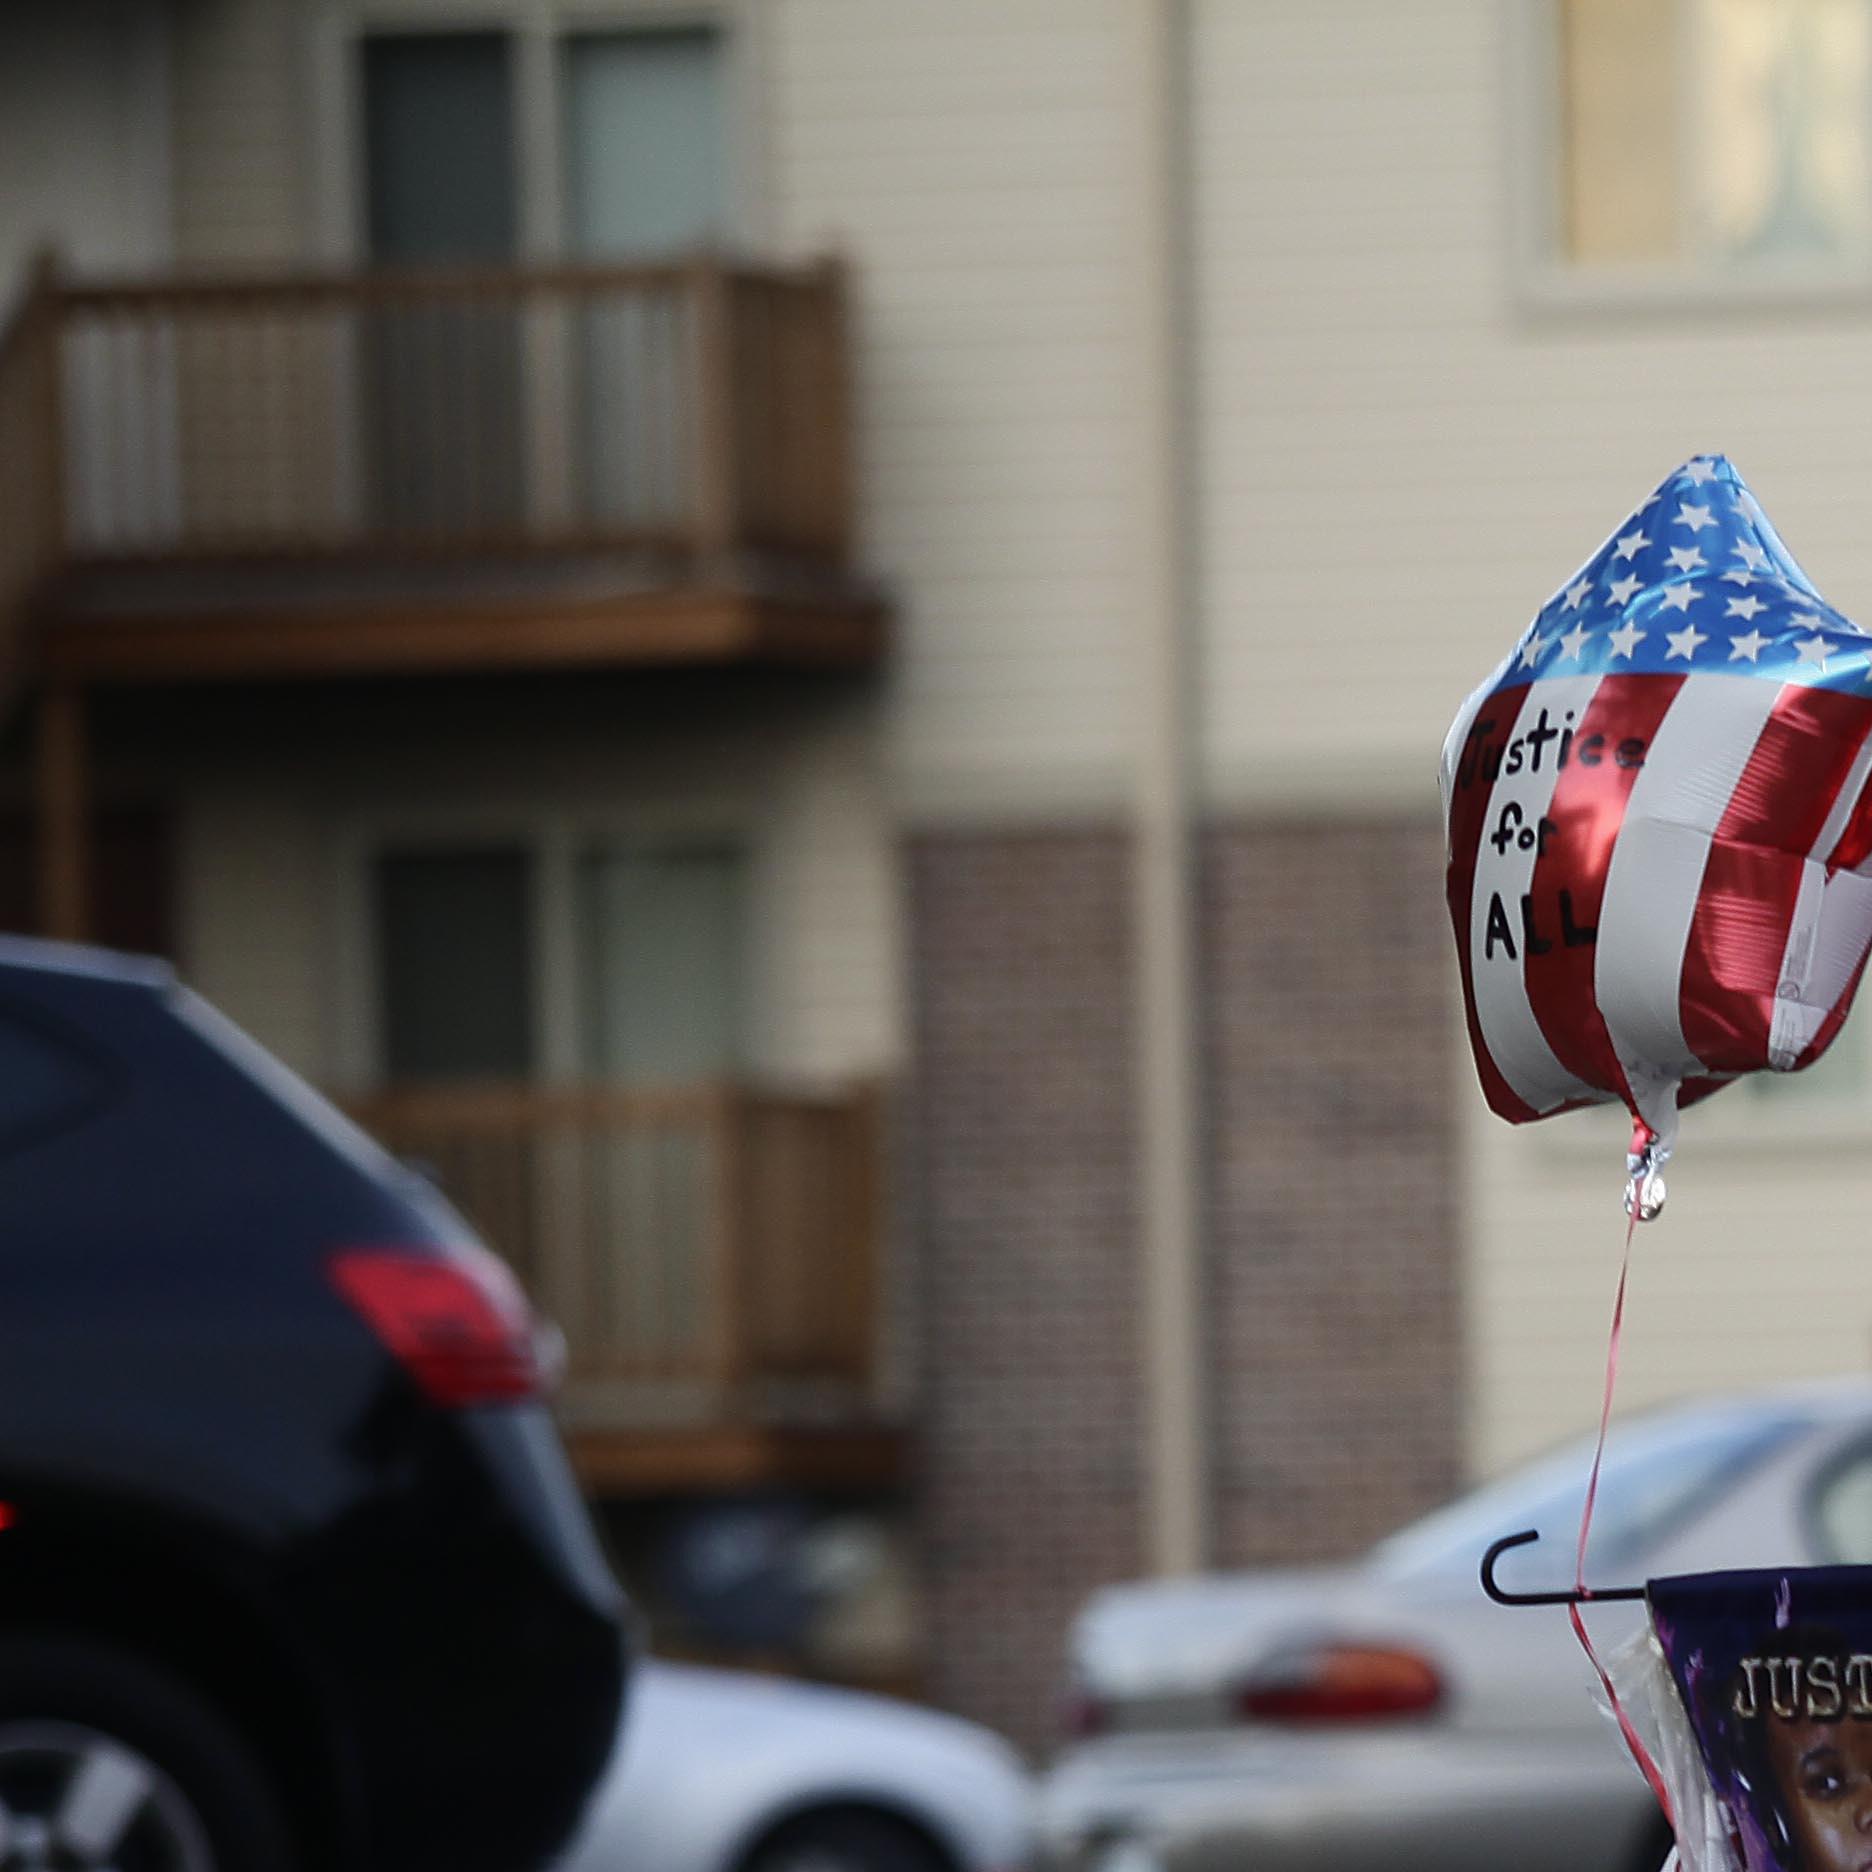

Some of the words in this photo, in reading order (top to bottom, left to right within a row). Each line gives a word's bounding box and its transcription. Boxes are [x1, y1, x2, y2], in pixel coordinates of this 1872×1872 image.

[1461, 708, 1647, 792] Justice
[1490, 801, 1558, 858] for
[1484, 890, 1598, 961] ALL
